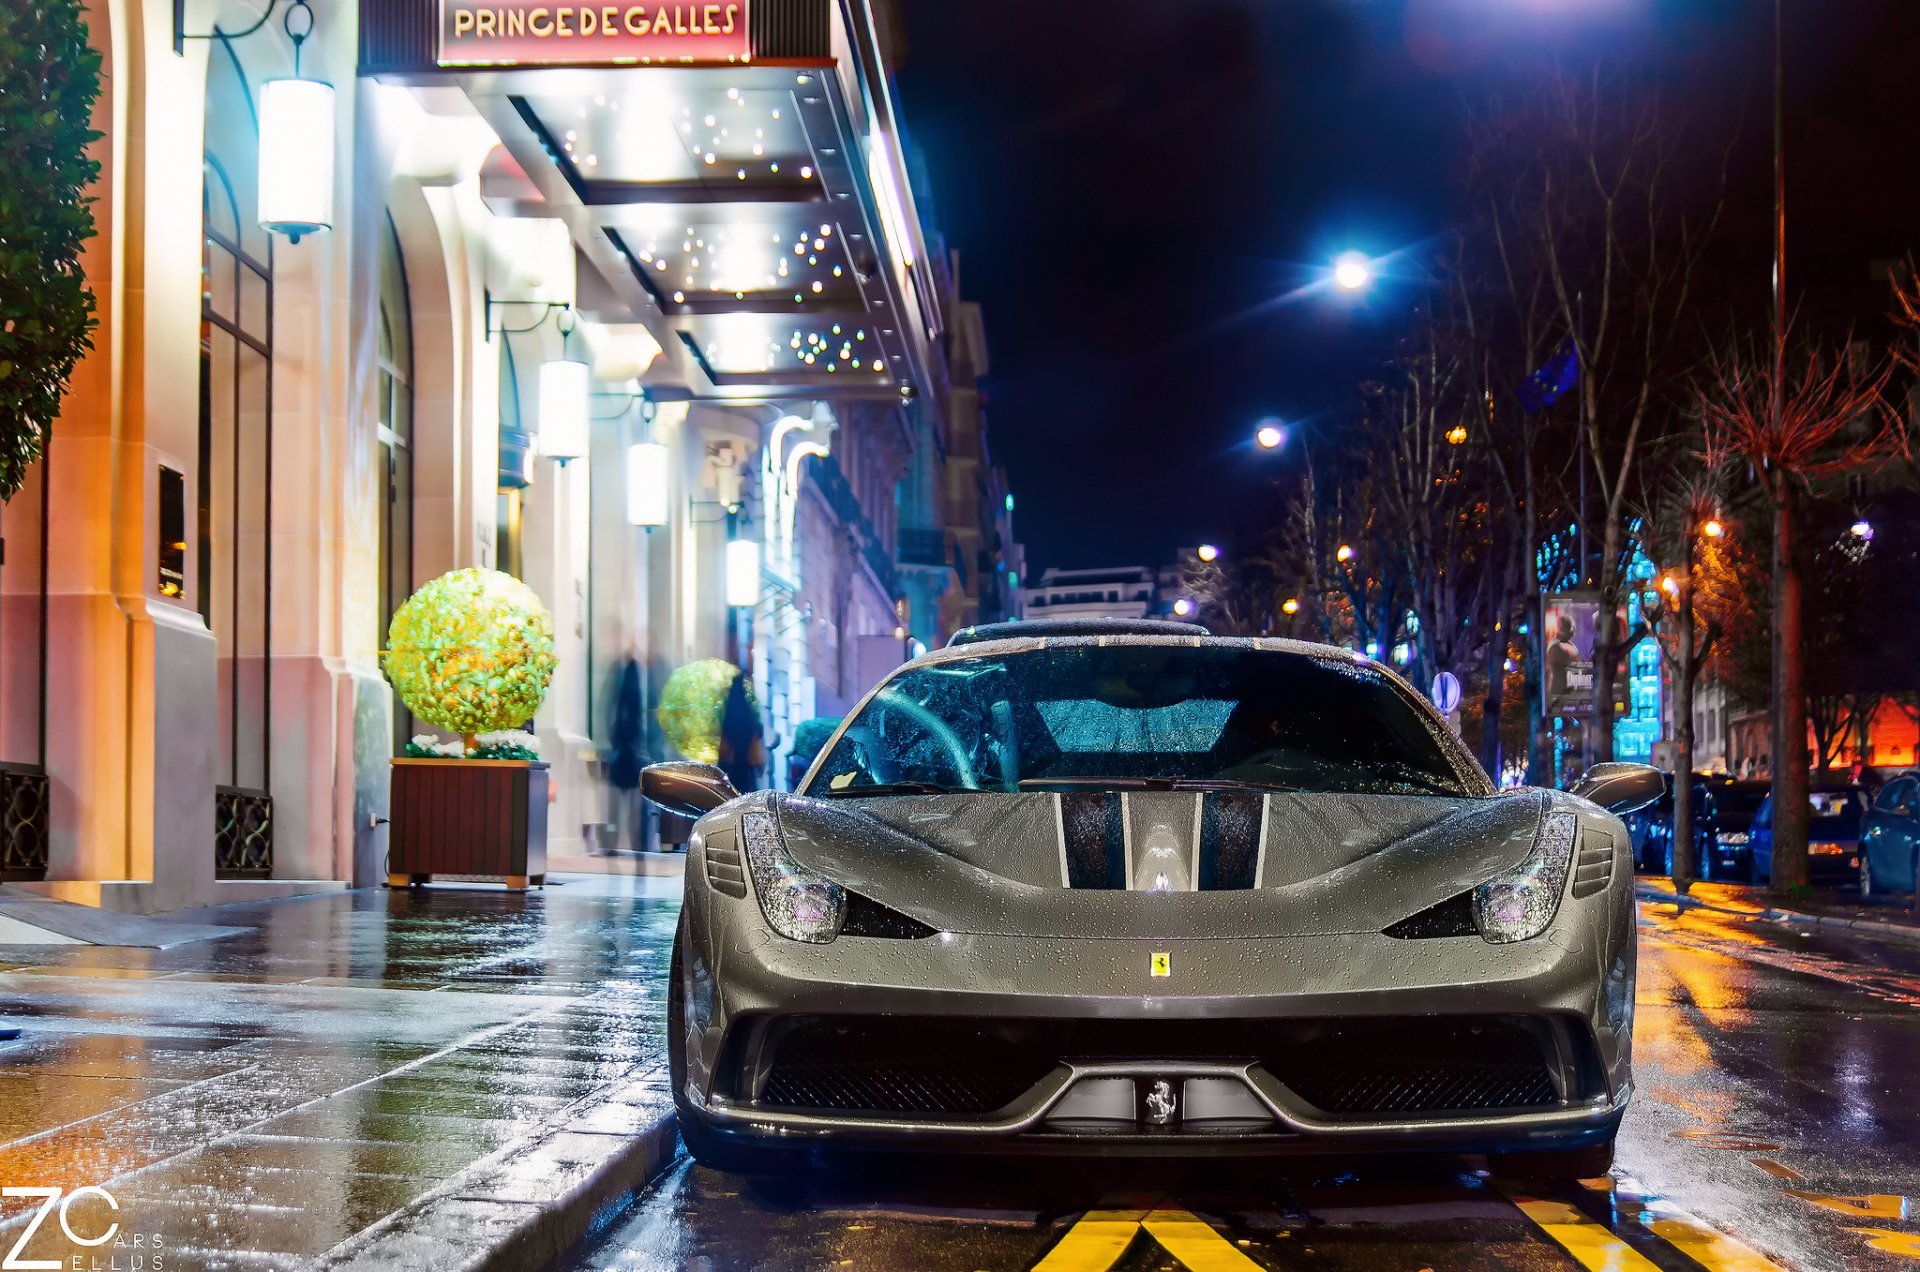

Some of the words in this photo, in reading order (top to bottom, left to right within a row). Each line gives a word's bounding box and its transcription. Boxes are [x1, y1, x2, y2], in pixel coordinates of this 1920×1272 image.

[455, 7, 574, 38] PRINCE
[580, 7, 619, 36] DE
[624, 4, 738, 36] GALLES
